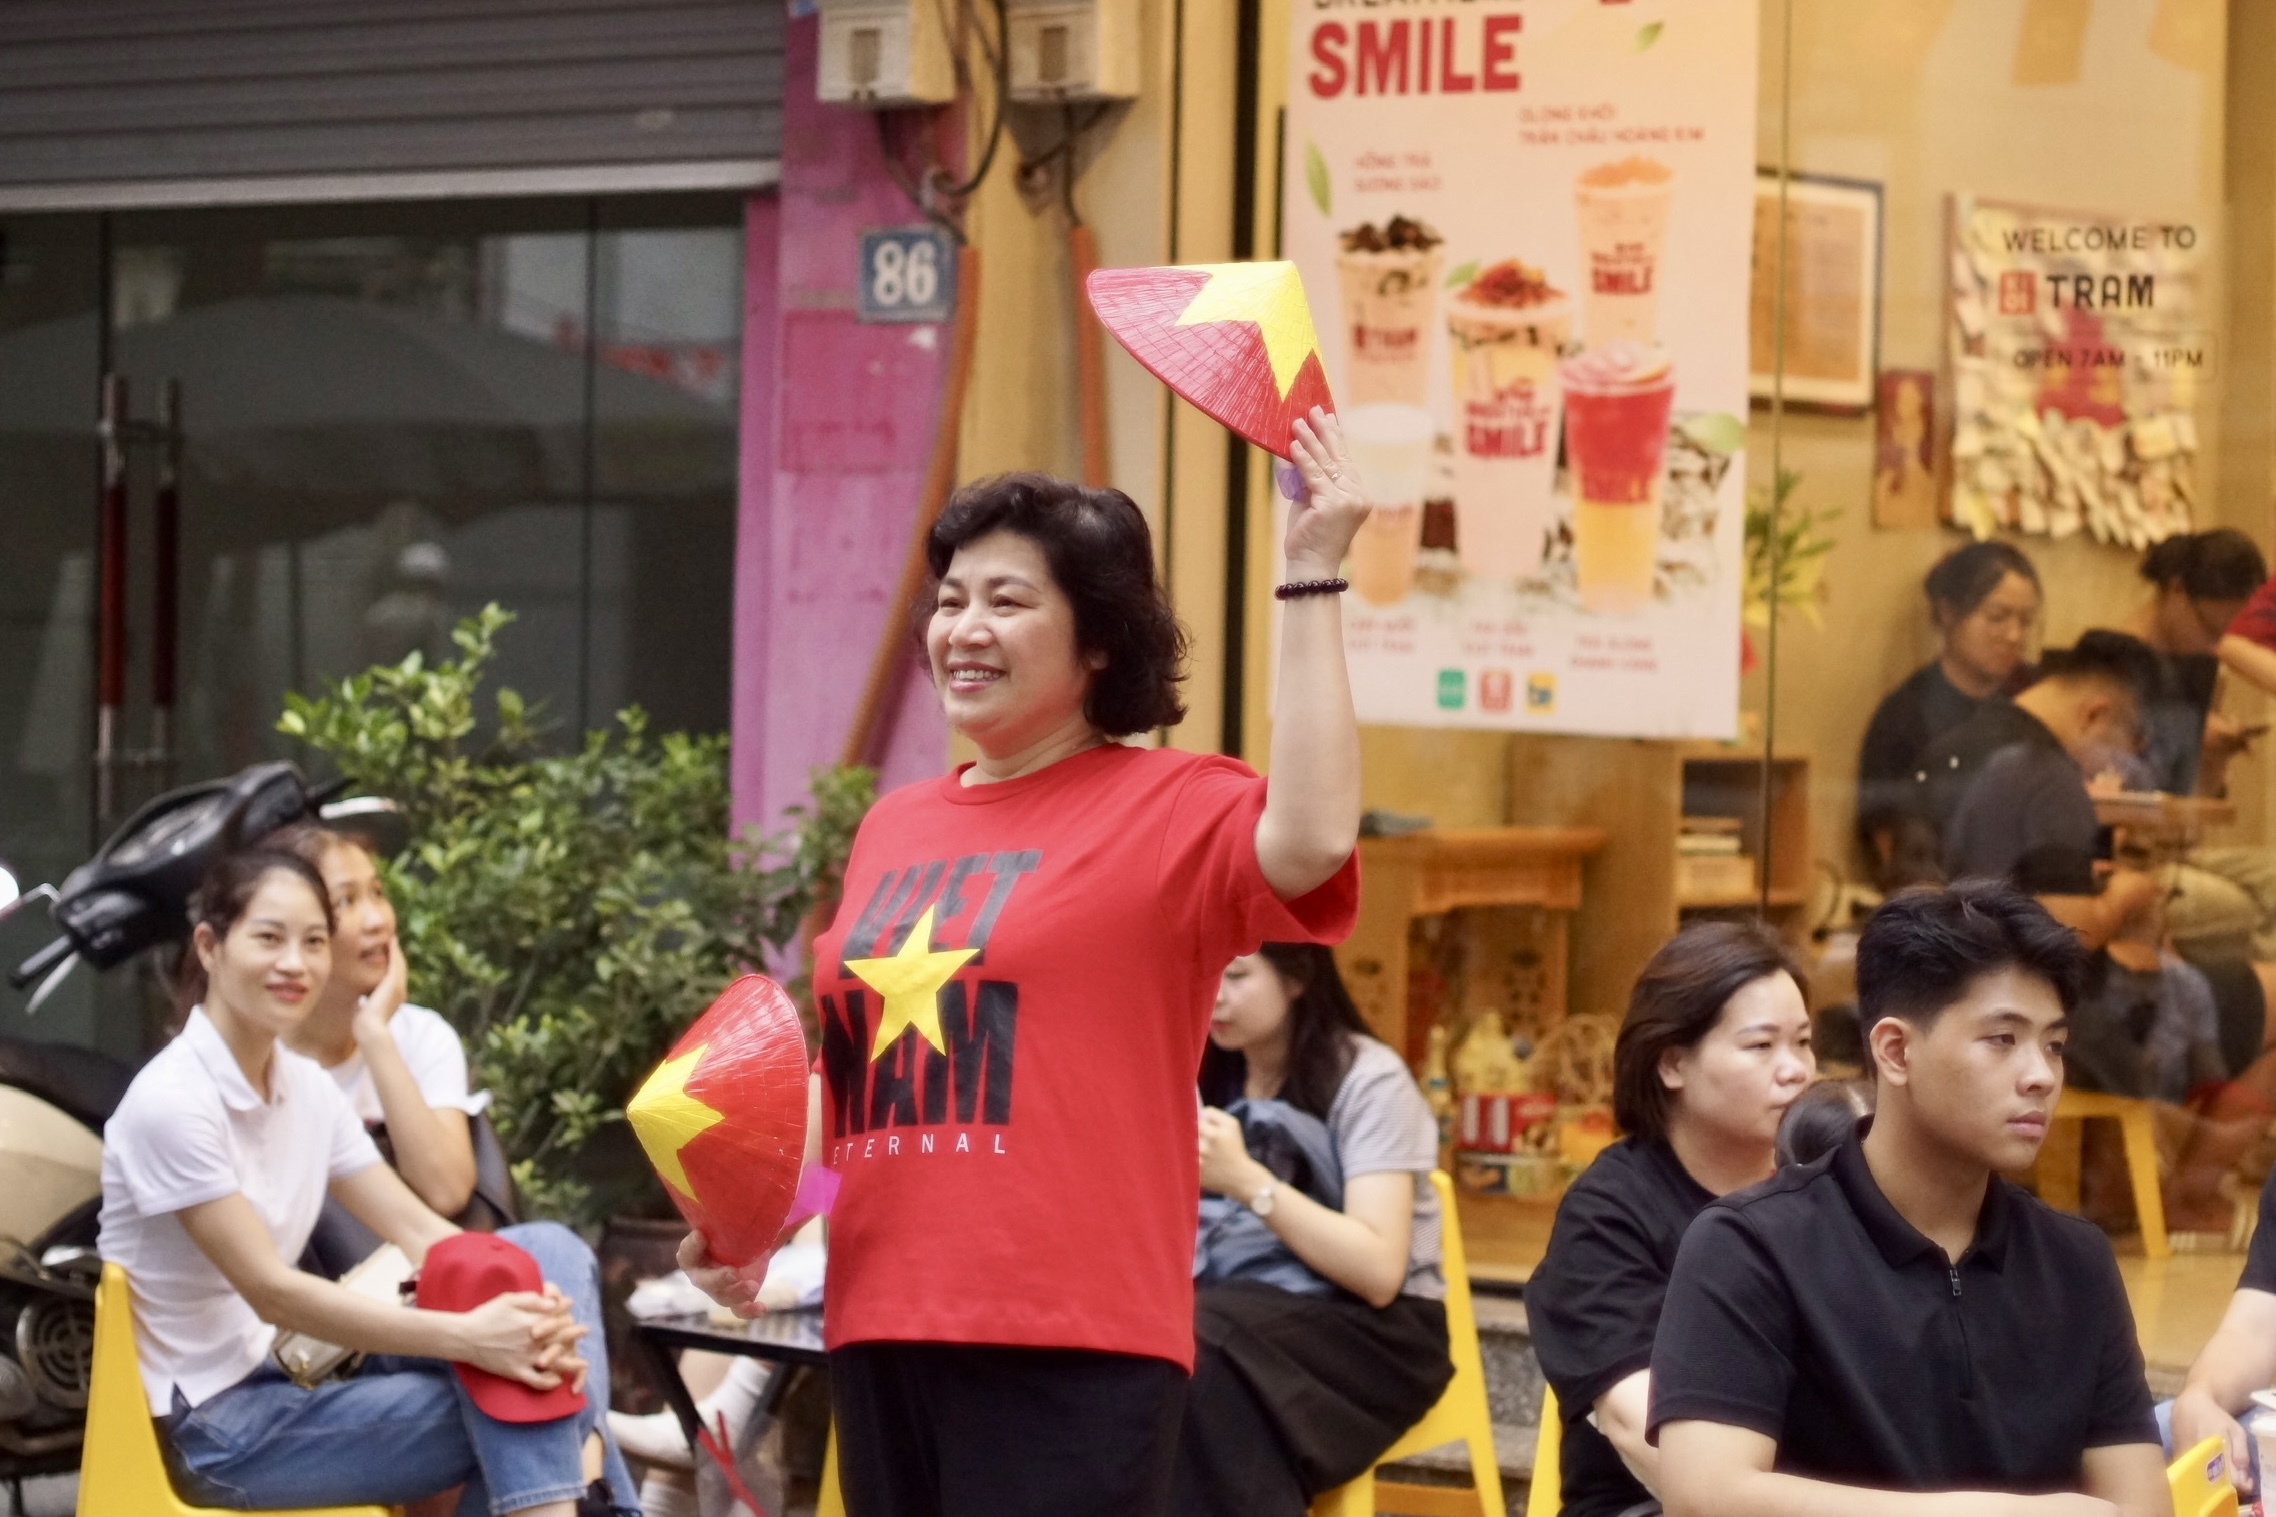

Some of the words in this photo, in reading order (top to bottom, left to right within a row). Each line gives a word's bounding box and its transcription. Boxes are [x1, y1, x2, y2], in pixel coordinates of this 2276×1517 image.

[1308, 14, 1523, 99] SMILE
[2002, 225, 2148, 254] WELCOME
[2161, 225, 2197, 250] TO
[873, 240, 938, 305] 86
[2046, 274, 2155, 309] TRAM
[2013, 348, 2072, 370] OPEN
[2080, 348, 2126, 368] 7AM
[2153, 347, 2204, 368] 11PM
[838, 849, 1044, 980] VIET
[821, 979, 1018, 1138] NAM
[833, 1133, 1006, 1165] ETERNAL
